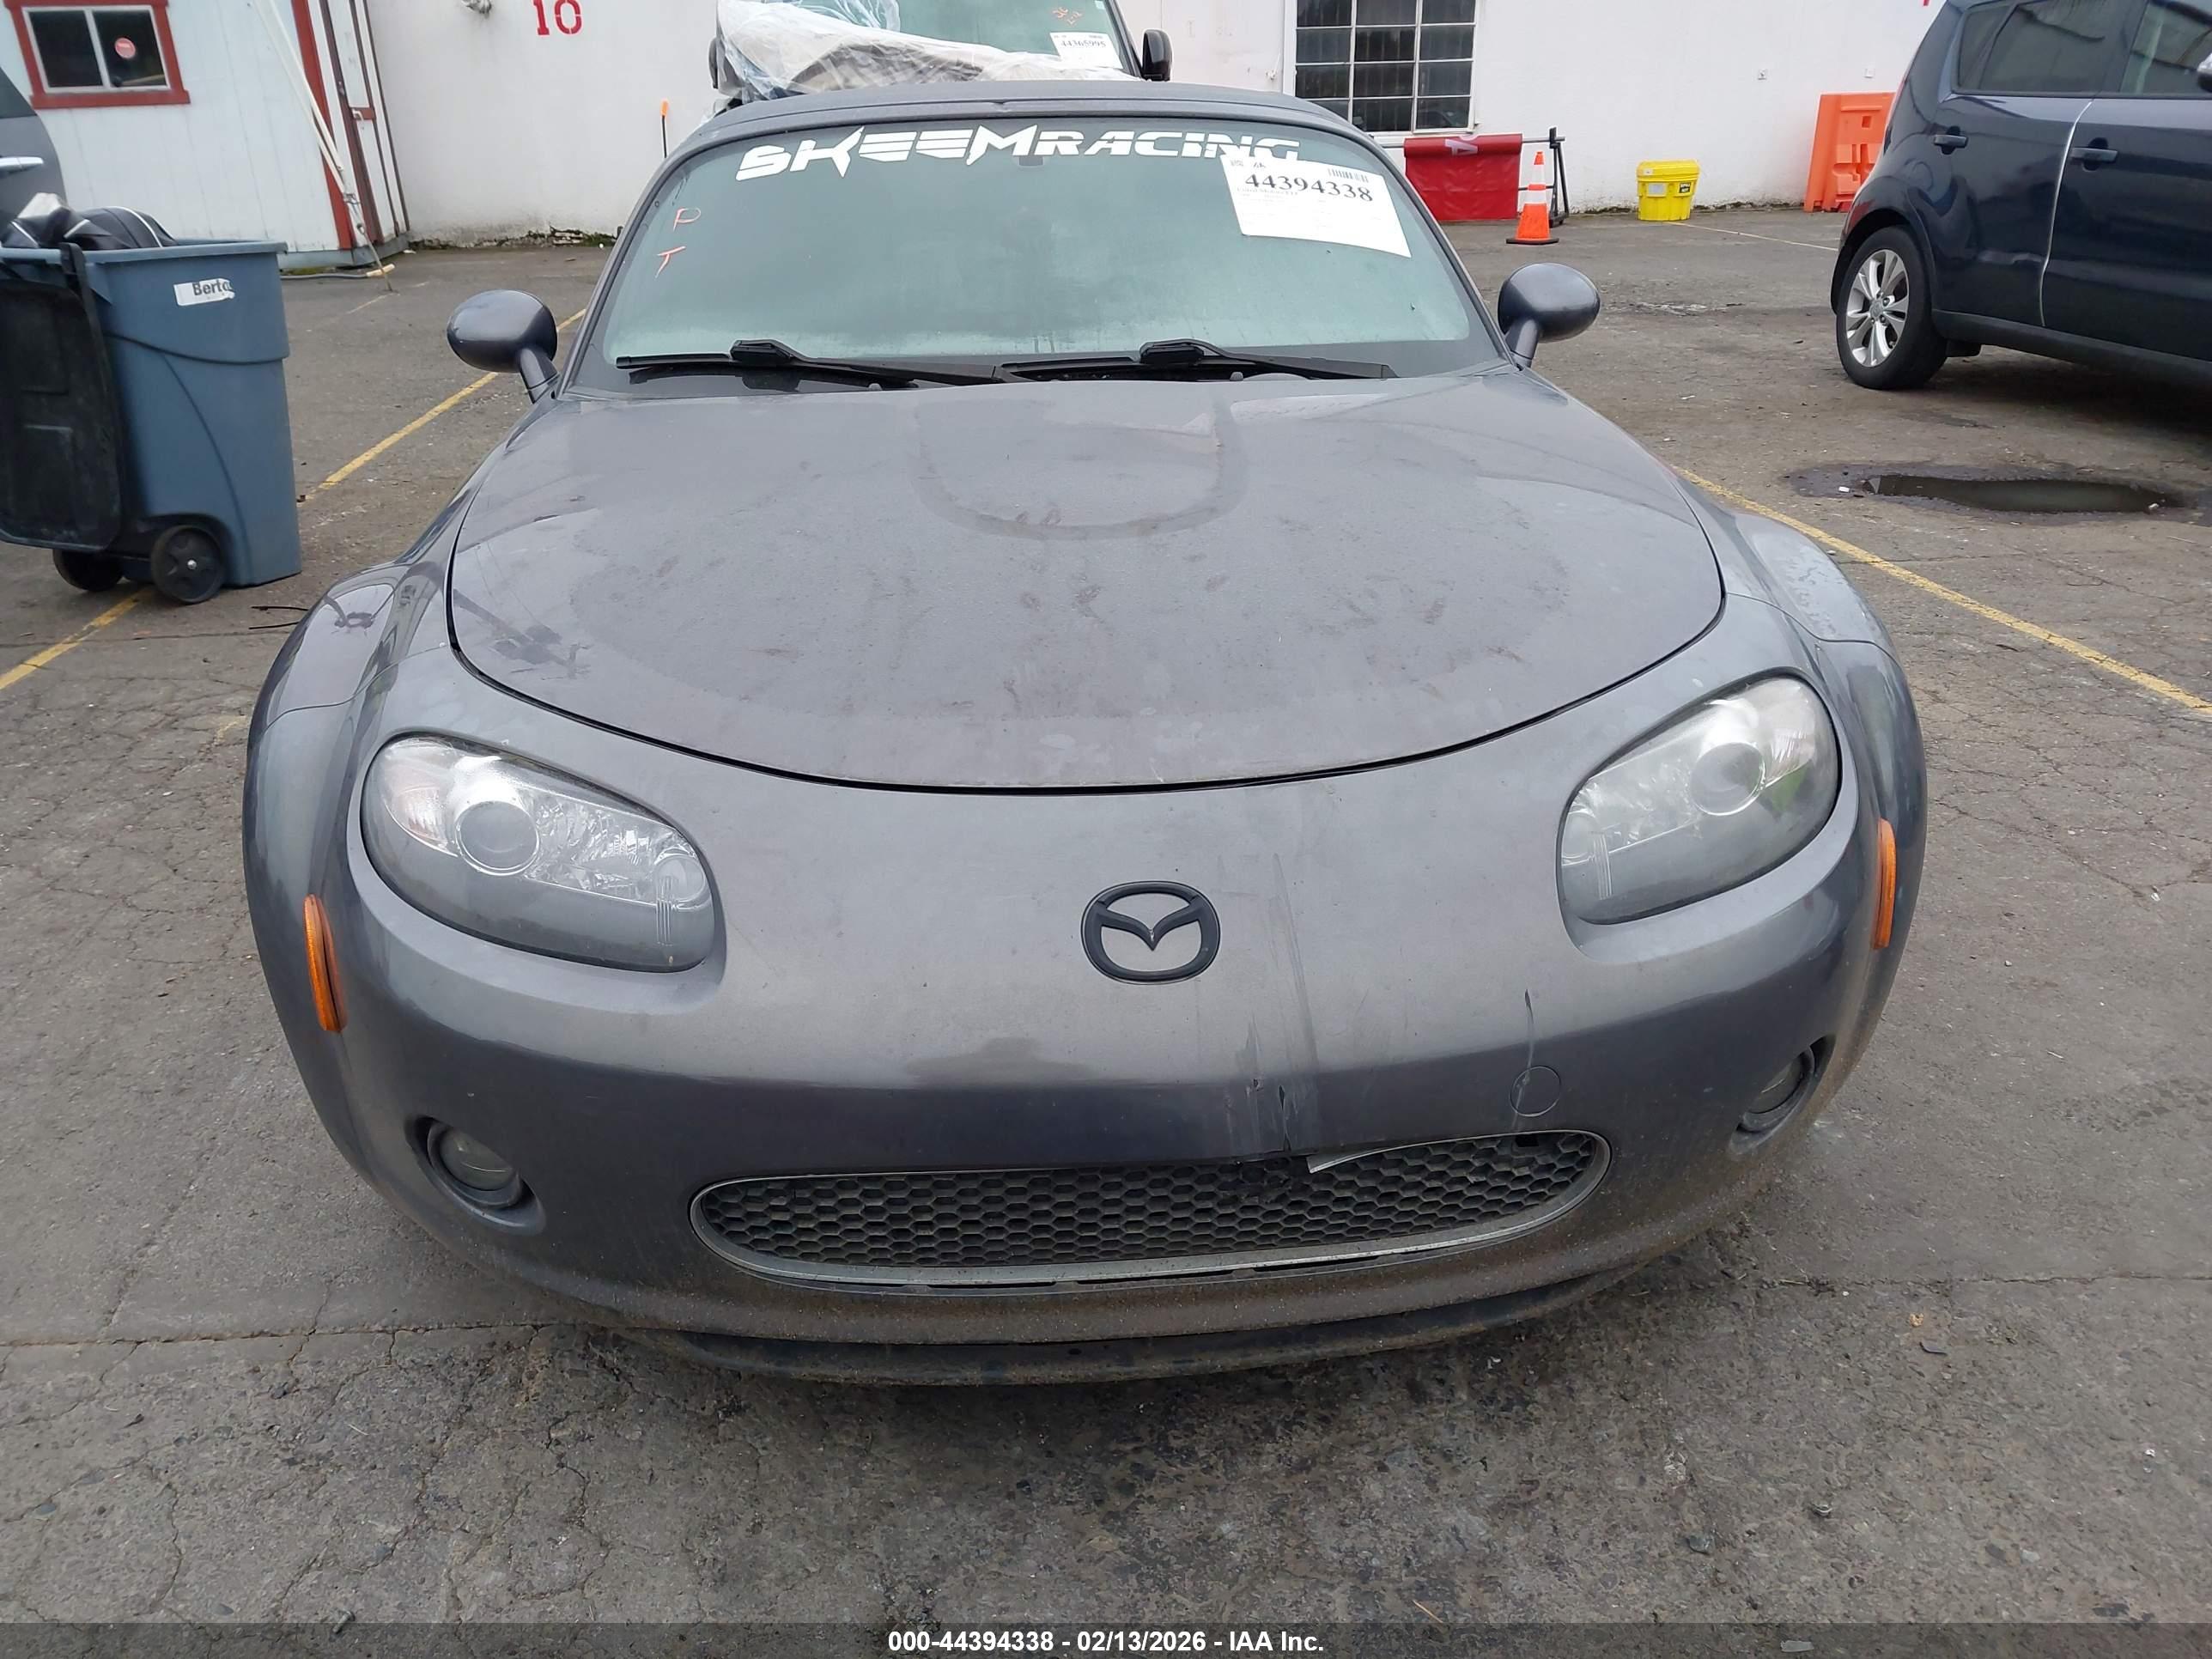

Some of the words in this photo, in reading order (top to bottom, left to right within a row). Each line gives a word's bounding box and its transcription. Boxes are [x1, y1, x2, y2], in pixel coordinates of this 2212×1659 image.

[532, 0, 582, 35] 10
[1245, 173, 1374, 202] 44394338
[673, 208, 702, 232] P
